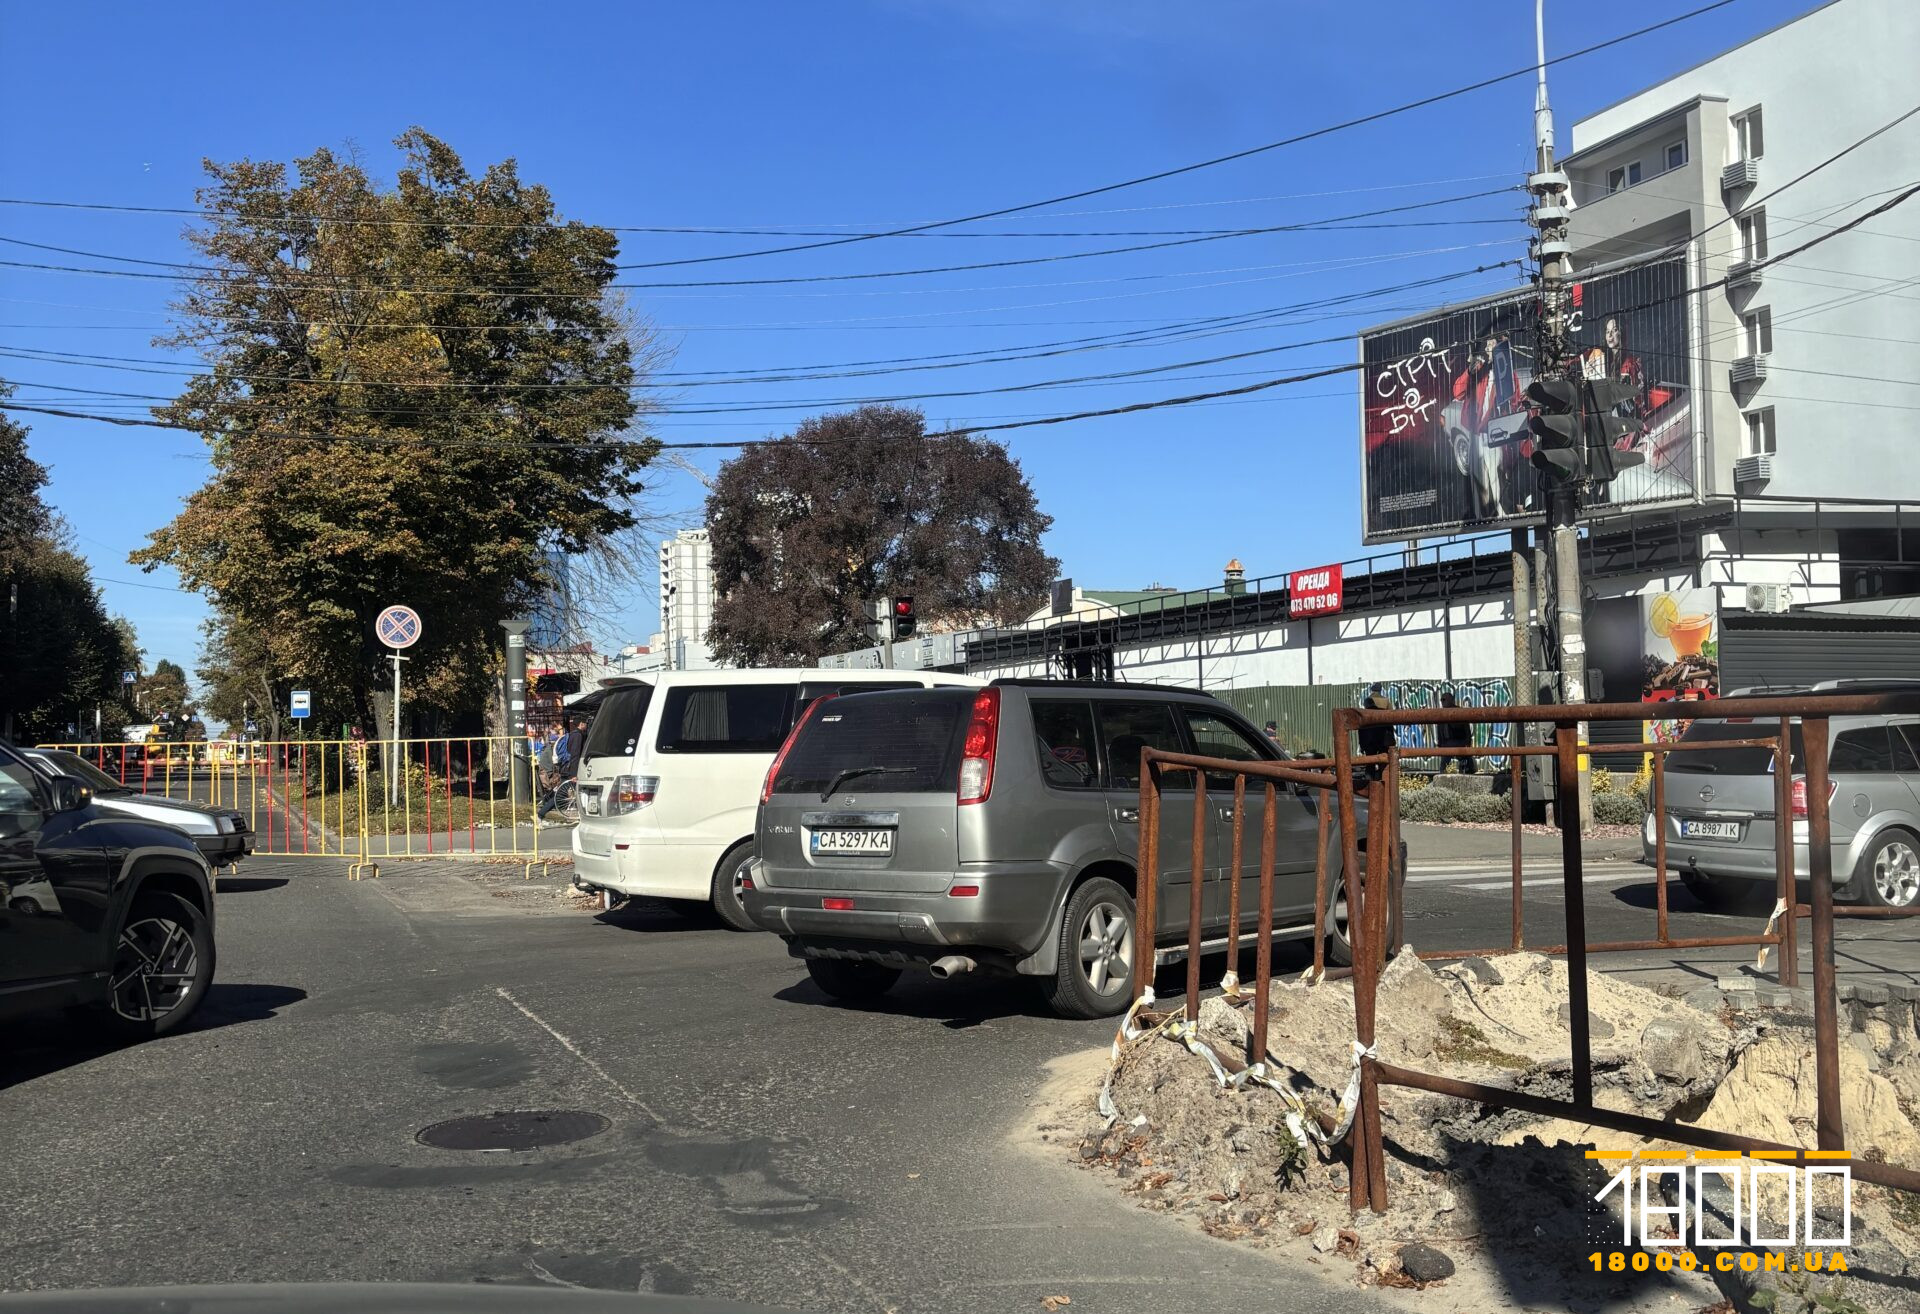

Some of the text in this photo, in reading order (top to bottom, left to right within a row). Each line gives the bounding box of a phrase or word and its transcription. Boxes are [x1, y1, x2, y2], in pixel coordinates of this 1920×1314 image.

[1377, 338, 1458, 397] СТРІТ
[1381, 388, 1437, 434] БІТ
[1297, 571, 1330, 591] ОРЕНДА
[1290, 592, 1338, 612] 073 470 52 06
[1688, 823, 1736, 836] CA 8987 IK
[820, 832, 889, 848] CA 5297 KA
